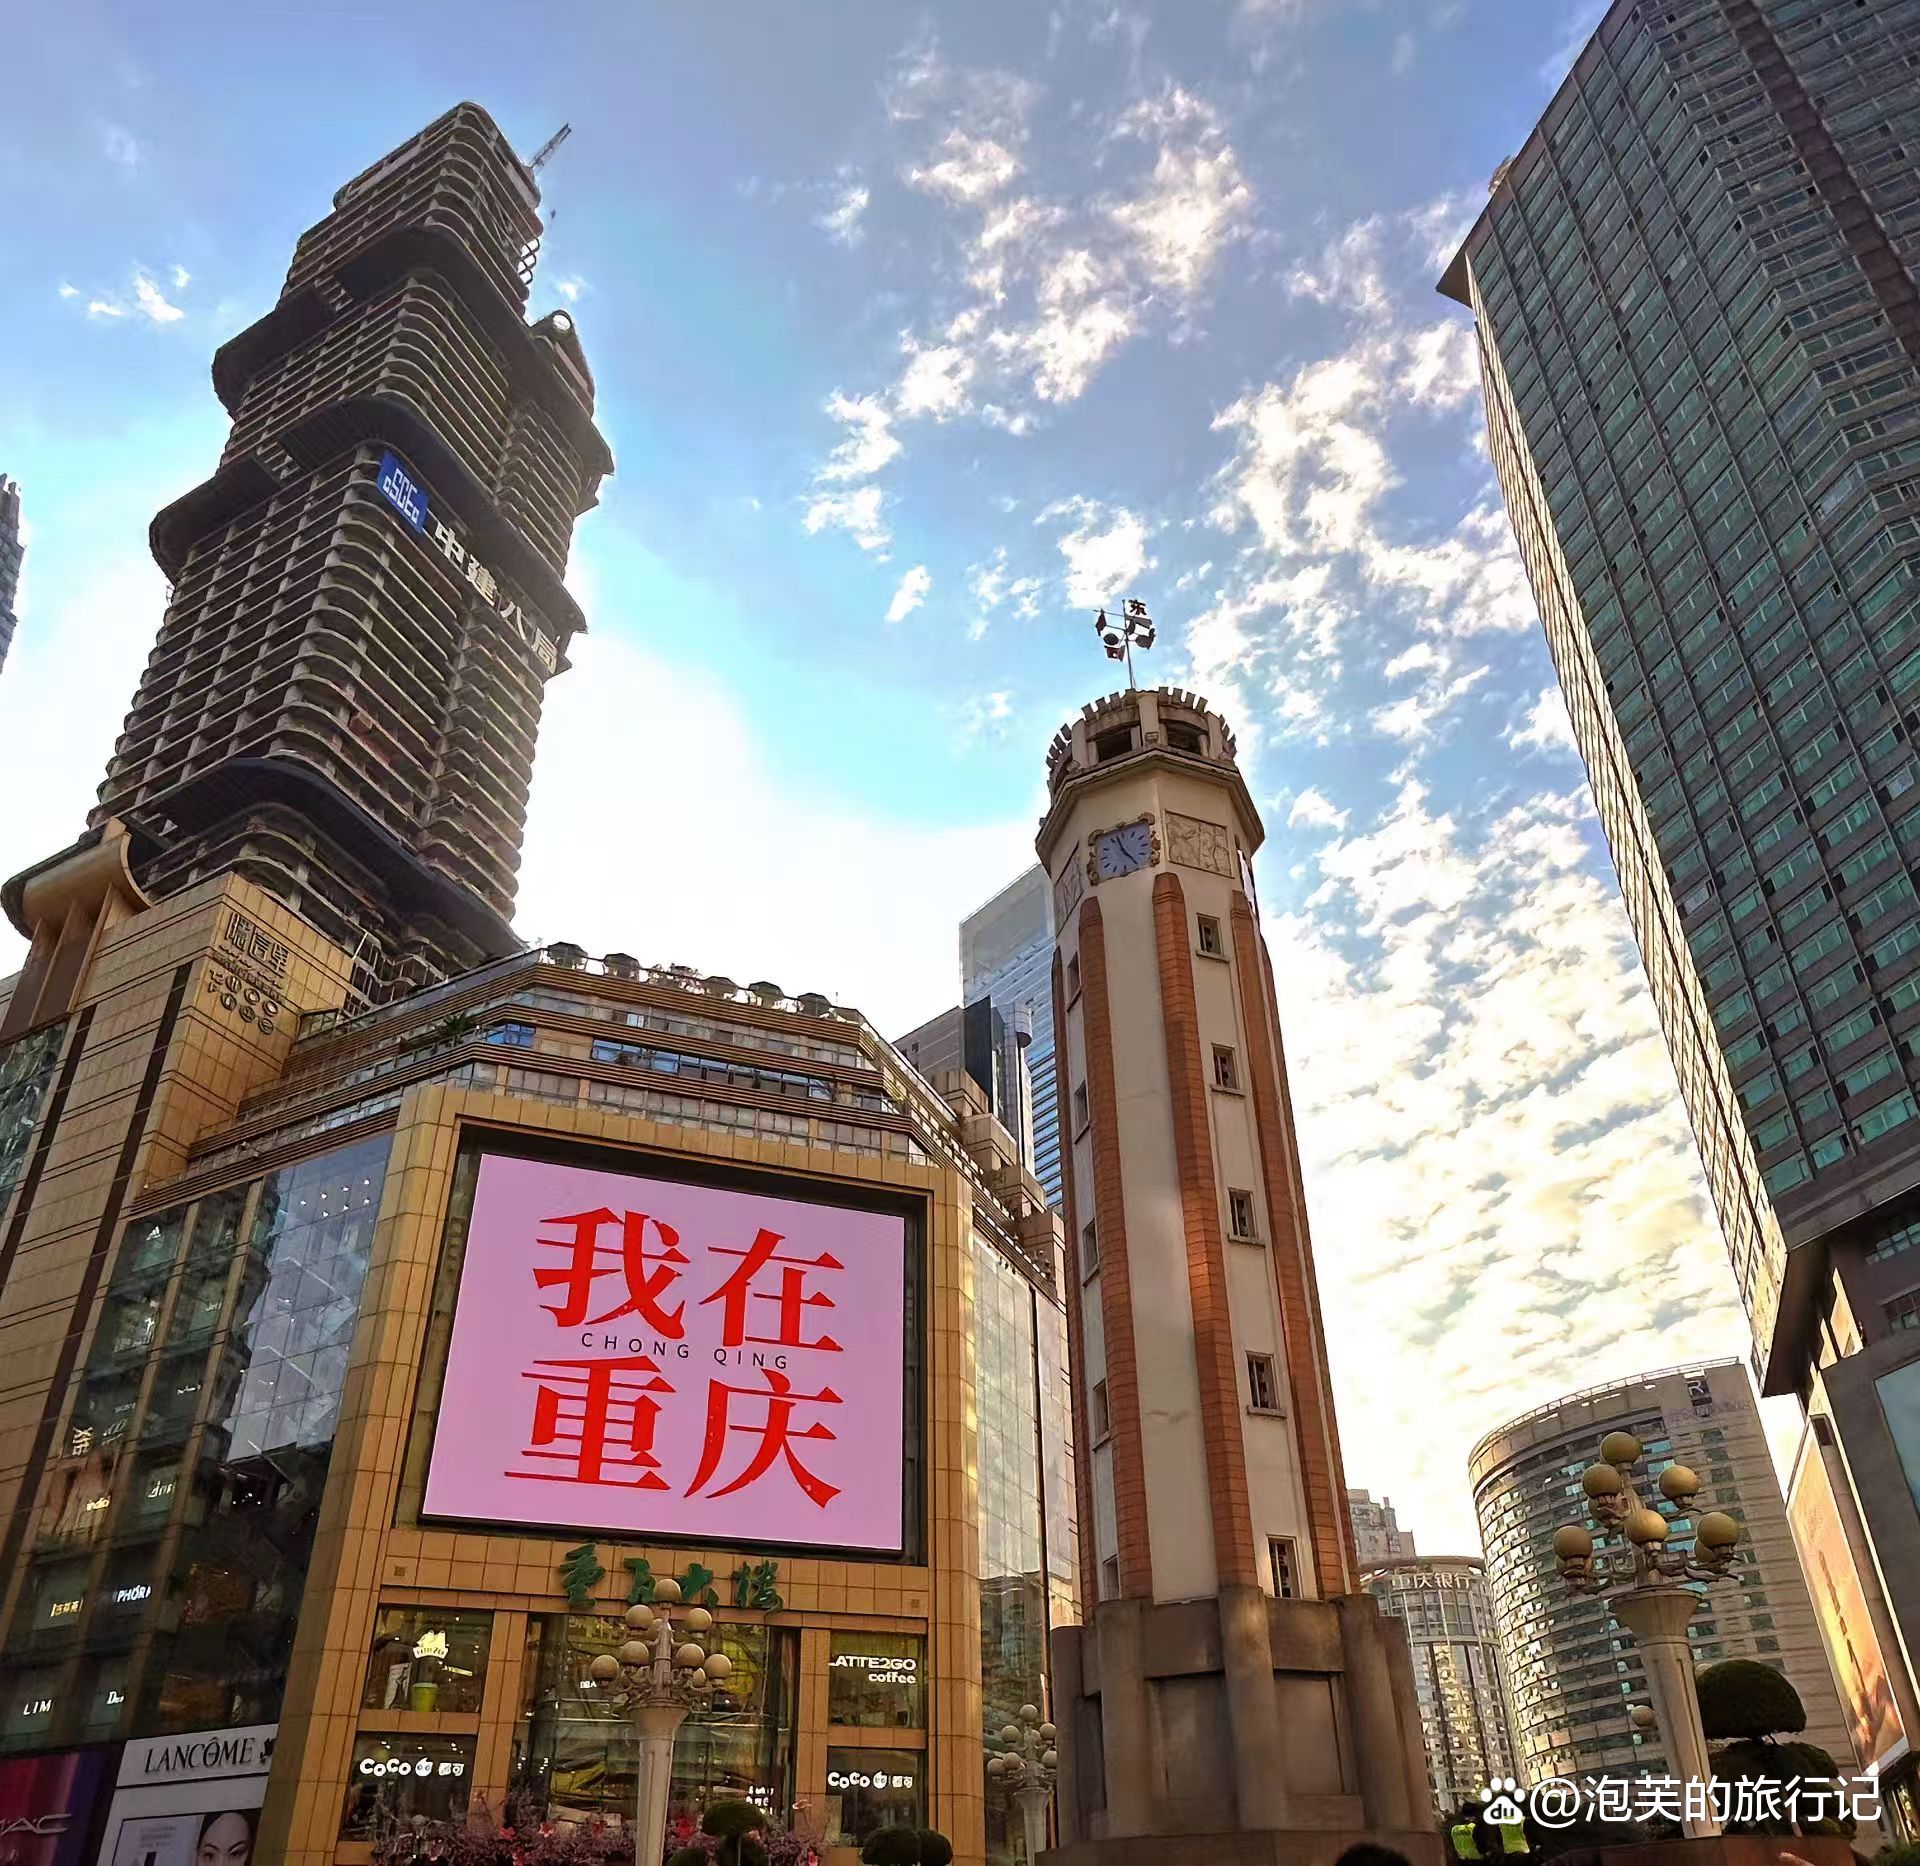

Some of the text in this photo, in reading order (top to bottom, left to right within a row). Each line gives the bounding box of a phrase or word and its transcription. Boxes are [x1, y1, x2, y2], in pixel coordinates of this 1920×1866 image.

[434, 520, 557, 674] 中建八局
[532, 1207, 845, 1352] 我在
[581, 1332, 789, 1370] CHONG QING
[504, 1355, 845, 1509] 重庆
[868, 1671, 917, 1685] coffee
[145, 1737, 256, 1773] LANCÔME
